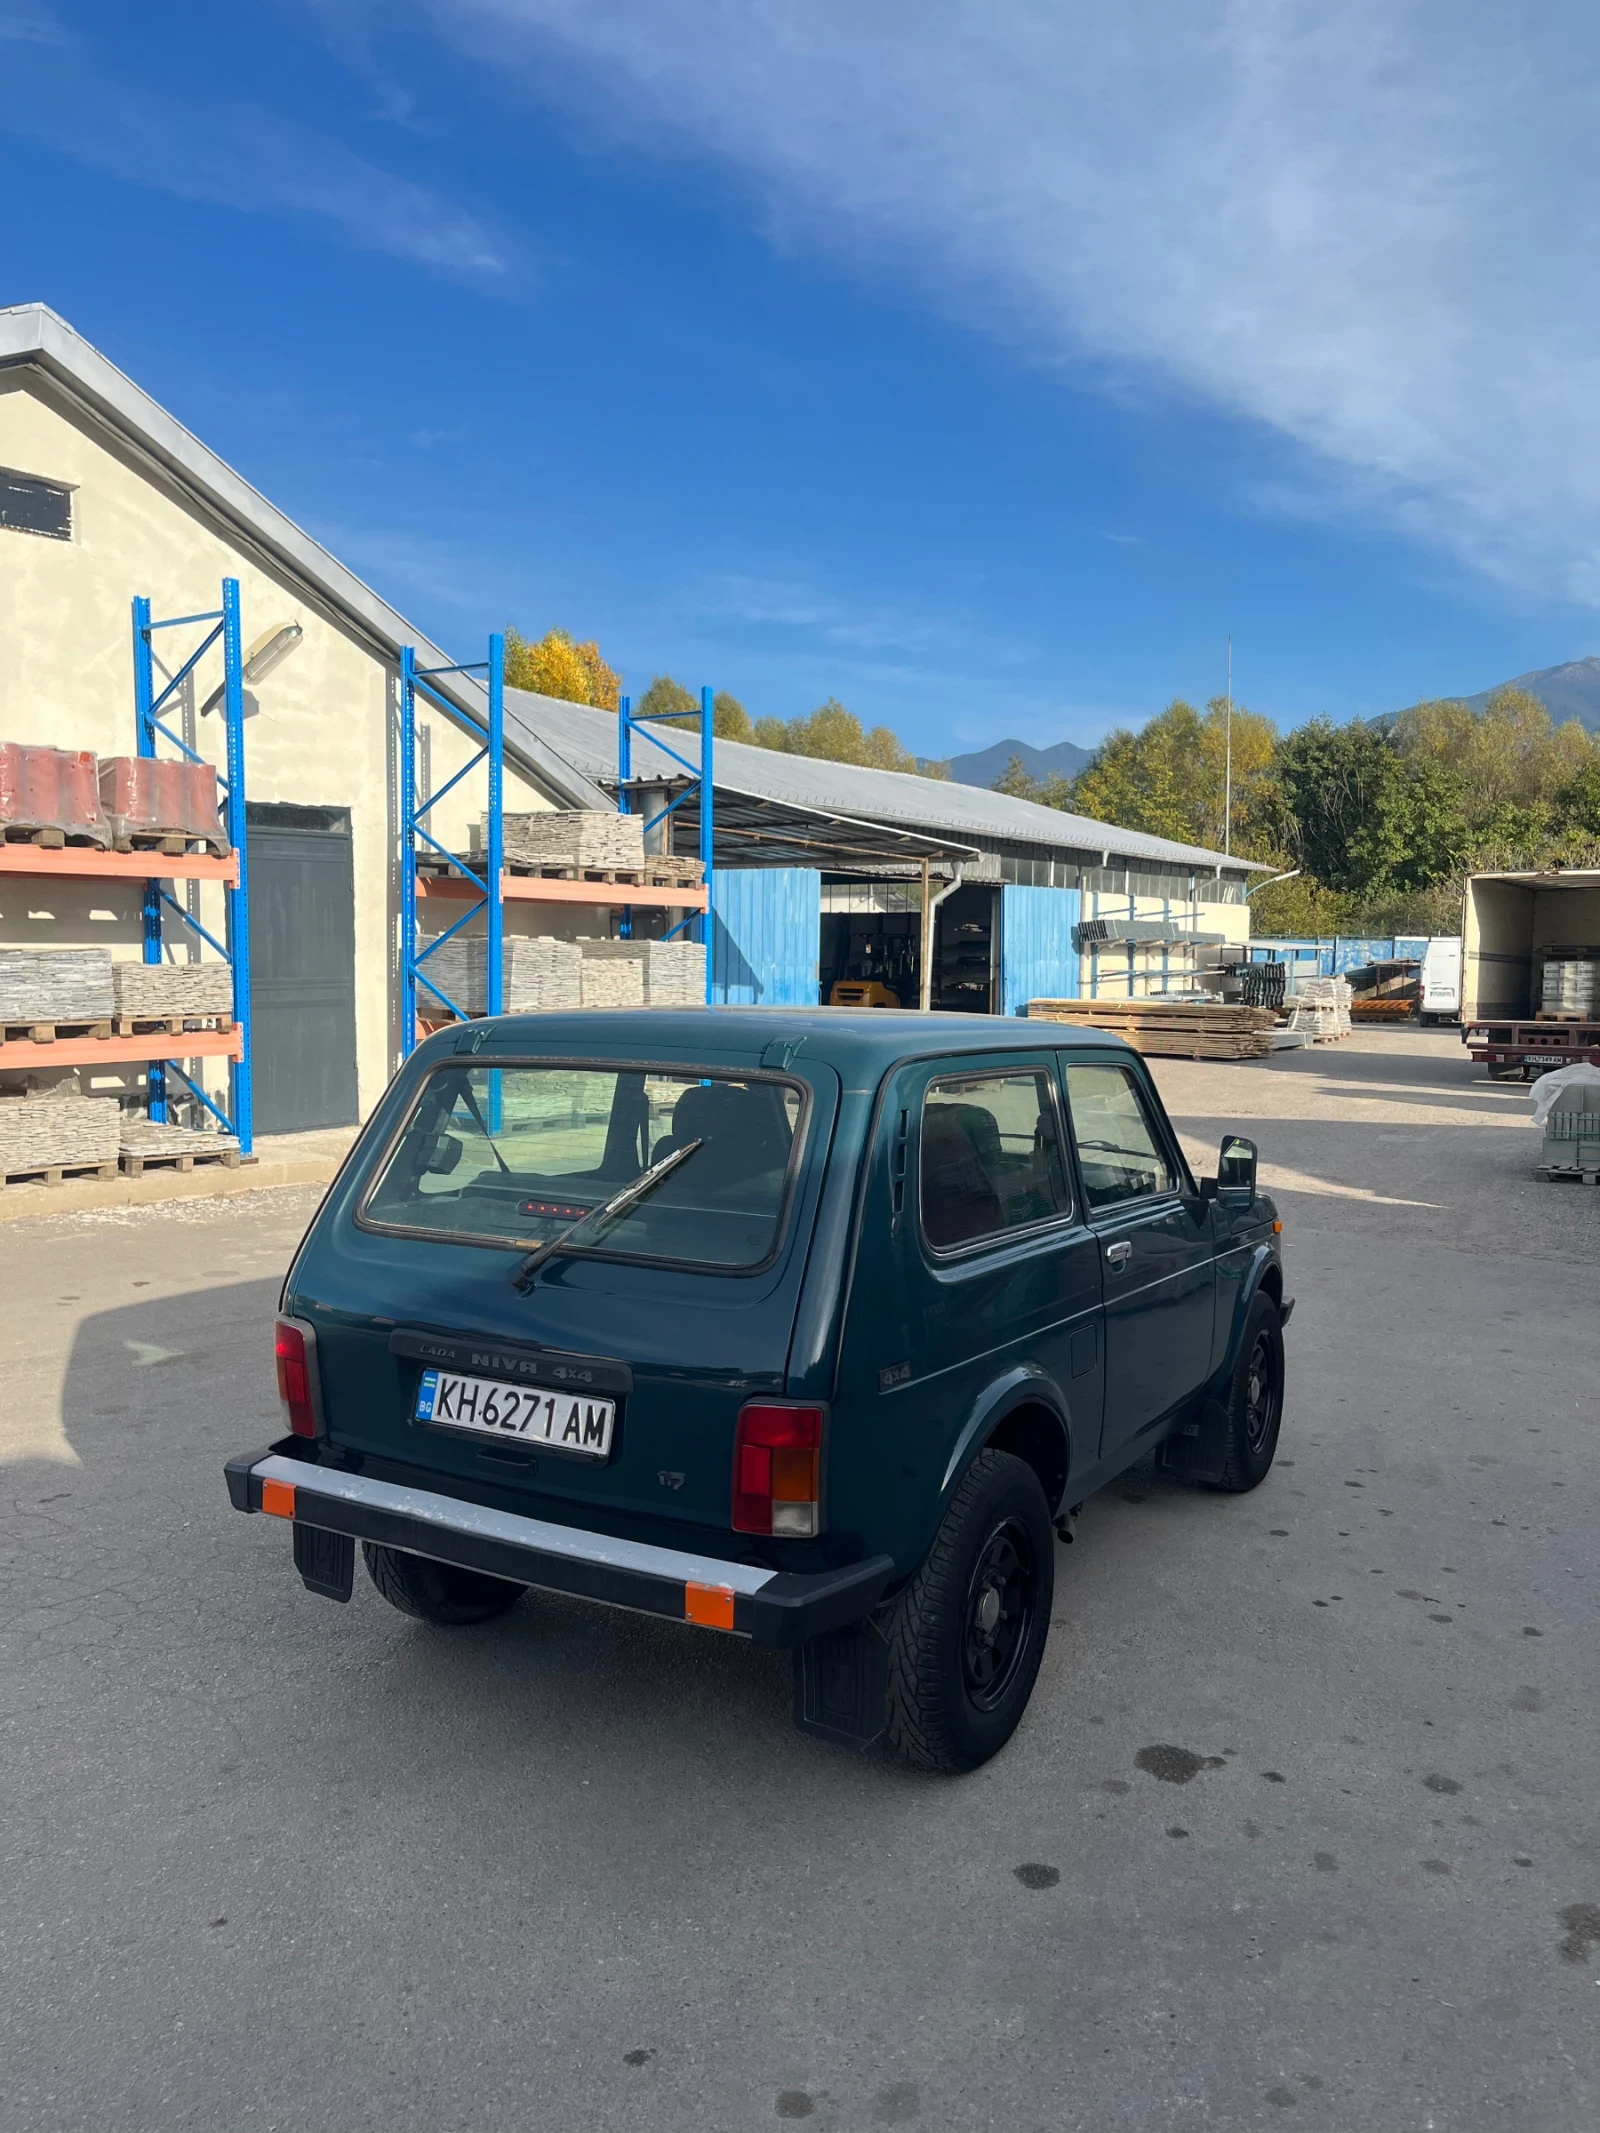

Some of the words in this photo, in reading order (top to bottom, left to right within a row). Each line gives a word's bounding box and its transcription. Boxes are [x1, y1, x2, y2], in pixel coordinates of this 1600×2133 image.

[419, 1344, 456, 1359] LADA
[471, 1351, 539, 1375] NIVA
[419, 1400, 432, 1413] BG
